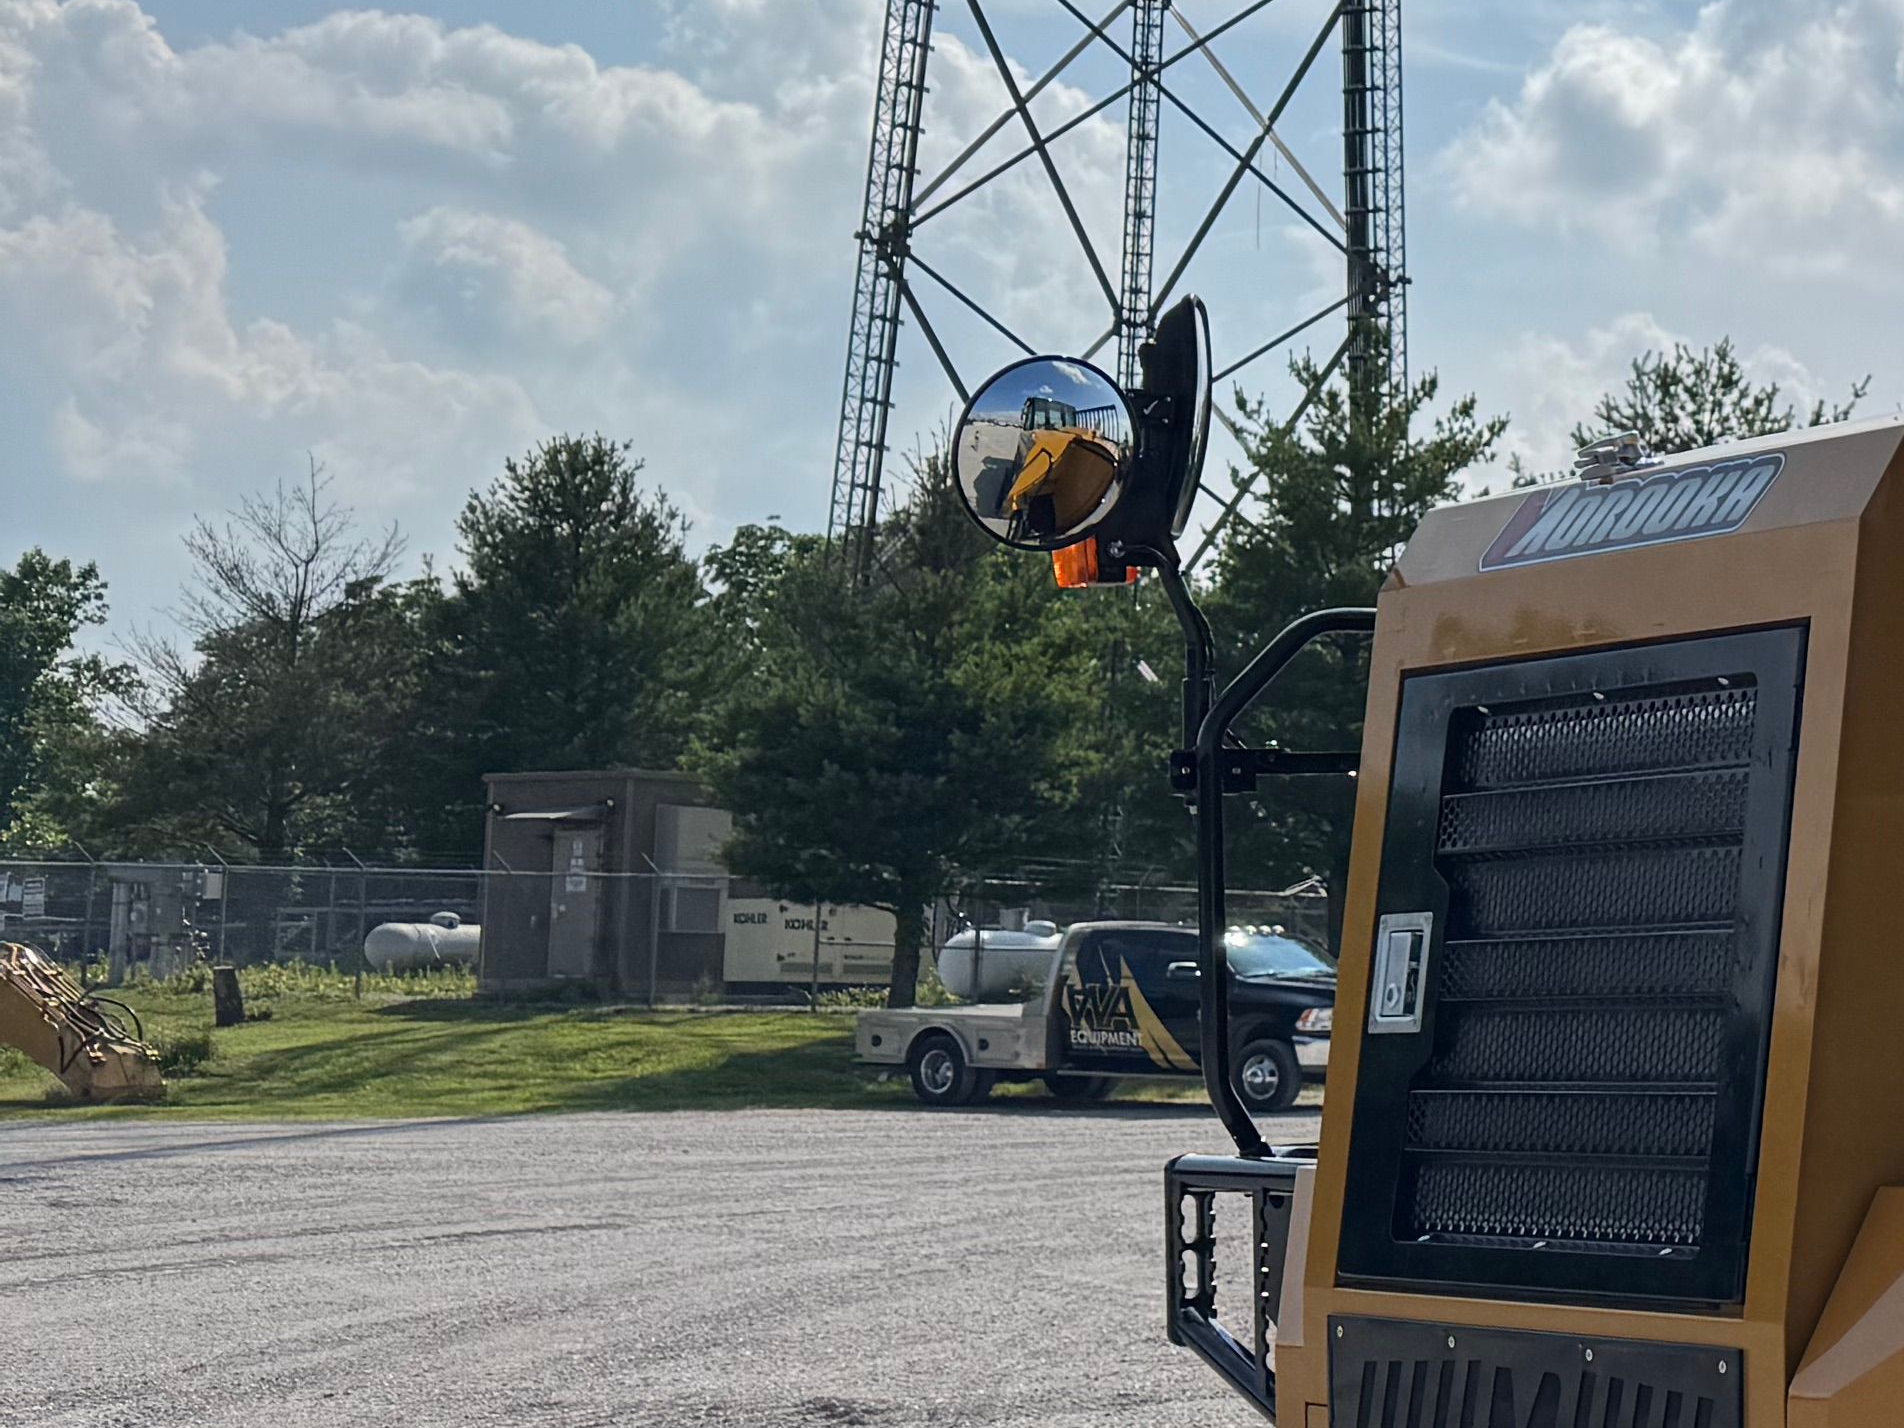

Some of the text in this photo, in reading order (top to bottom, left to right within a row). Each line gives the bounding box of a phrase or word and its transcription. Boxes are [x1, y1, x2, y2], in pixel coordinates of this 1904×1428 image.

[1483, 462, 1778, 567] MOROOKA
[732, 912, 768, 924] KOHLER
[784, 918, 829, 931] KOHLR
[1069, 1029, 1143, 1047] EQUIPMENT
